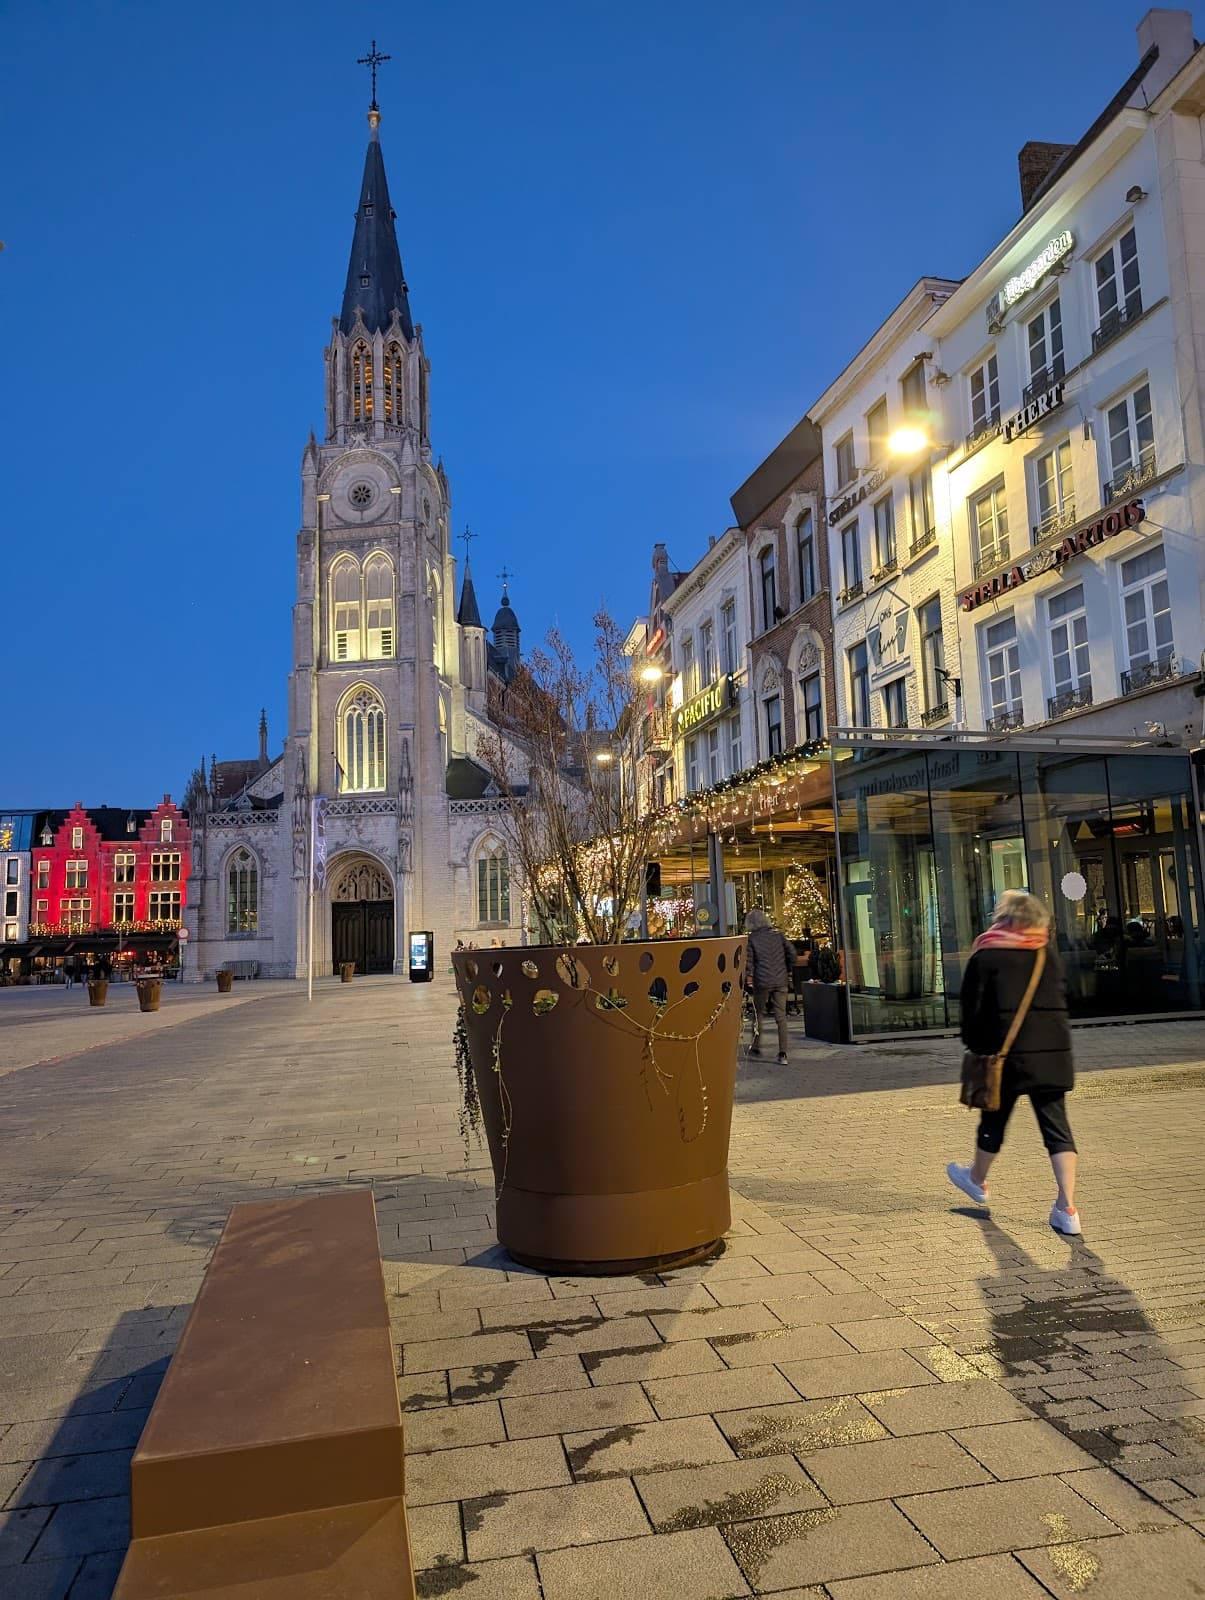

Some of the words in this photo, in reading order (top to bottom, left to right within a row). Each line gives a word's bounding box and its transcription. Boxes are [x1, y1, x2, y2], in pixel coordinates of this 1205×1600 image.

[962, 566, 1025, 612] STELLA
[1057, 498, 1146, 562] ARTOIS
[684, 686, 722, 729] PACIFIC
